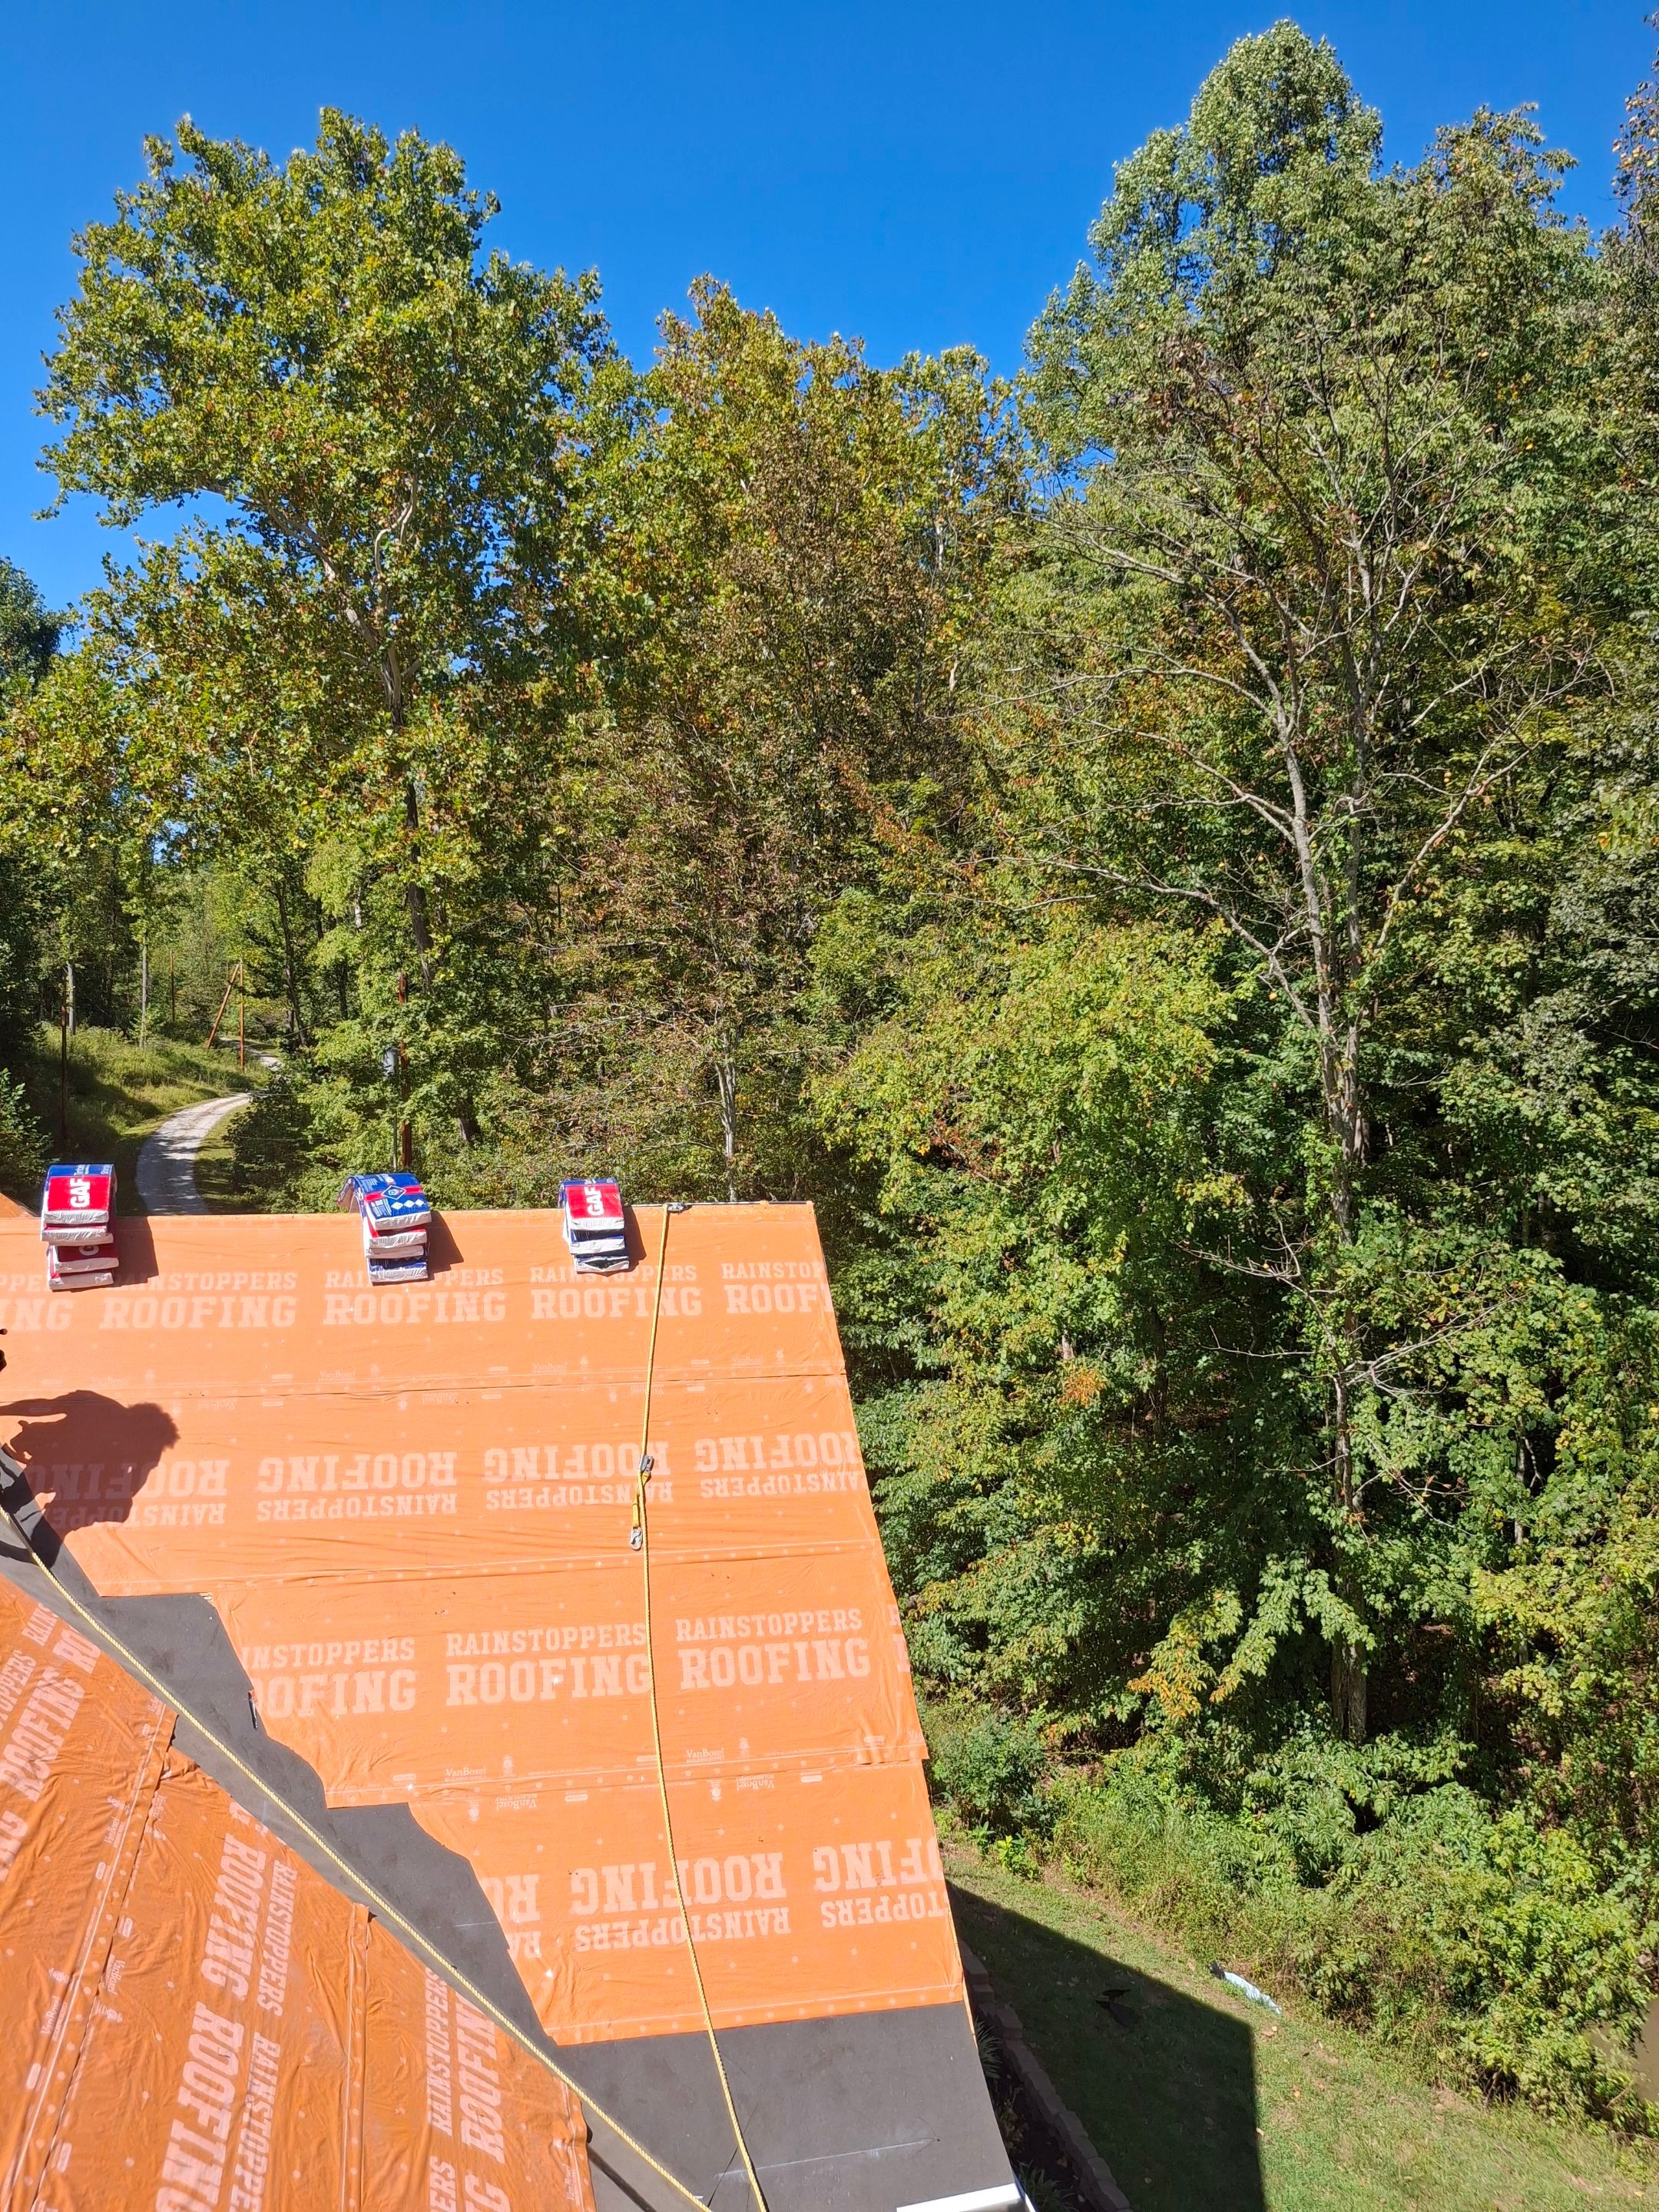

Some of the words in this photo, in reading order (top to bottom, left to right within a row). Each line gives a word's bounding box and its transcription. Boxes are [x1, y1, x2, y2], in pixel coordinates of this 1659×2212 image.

[70, 1177, 91, 1208] GAF
[584, 1185, 604, 1216] GAF
[99, 1295, 297, 1330] ROOFING
[323, 1290, 507, 1326] ROOFING
[531, 1286, 703, 1320] ROOFING
[257, 1451, 458, 1493] ROOFING
[483, 1441, 671, 1483] ROOFING
[257, 1492, 458, 1522] RAINSTOPPERS
[445, 1622, 647, 1657] RAINSTOPPERS
[676, 1608, 863, 1642] RAINSTOPPERS
[446, 1653, 653, 1707] ROOFING
[678, 1637, 872, 1690] ROOFING
[571, 1852, 787, 1916] ROOFING
[200, 1832, 267, 2002] ROOFING
[576, 1906, 792, 1953] RAINSTOPPERS
[820, 1891, 949, 1929] TOPPERS
[257, 1859, 298, 2017] RAINSTOPPERS
[455, 1991, 505, 2164] ROOFIN
[230, 2030, 282, 2212] RAINSTOPPE
